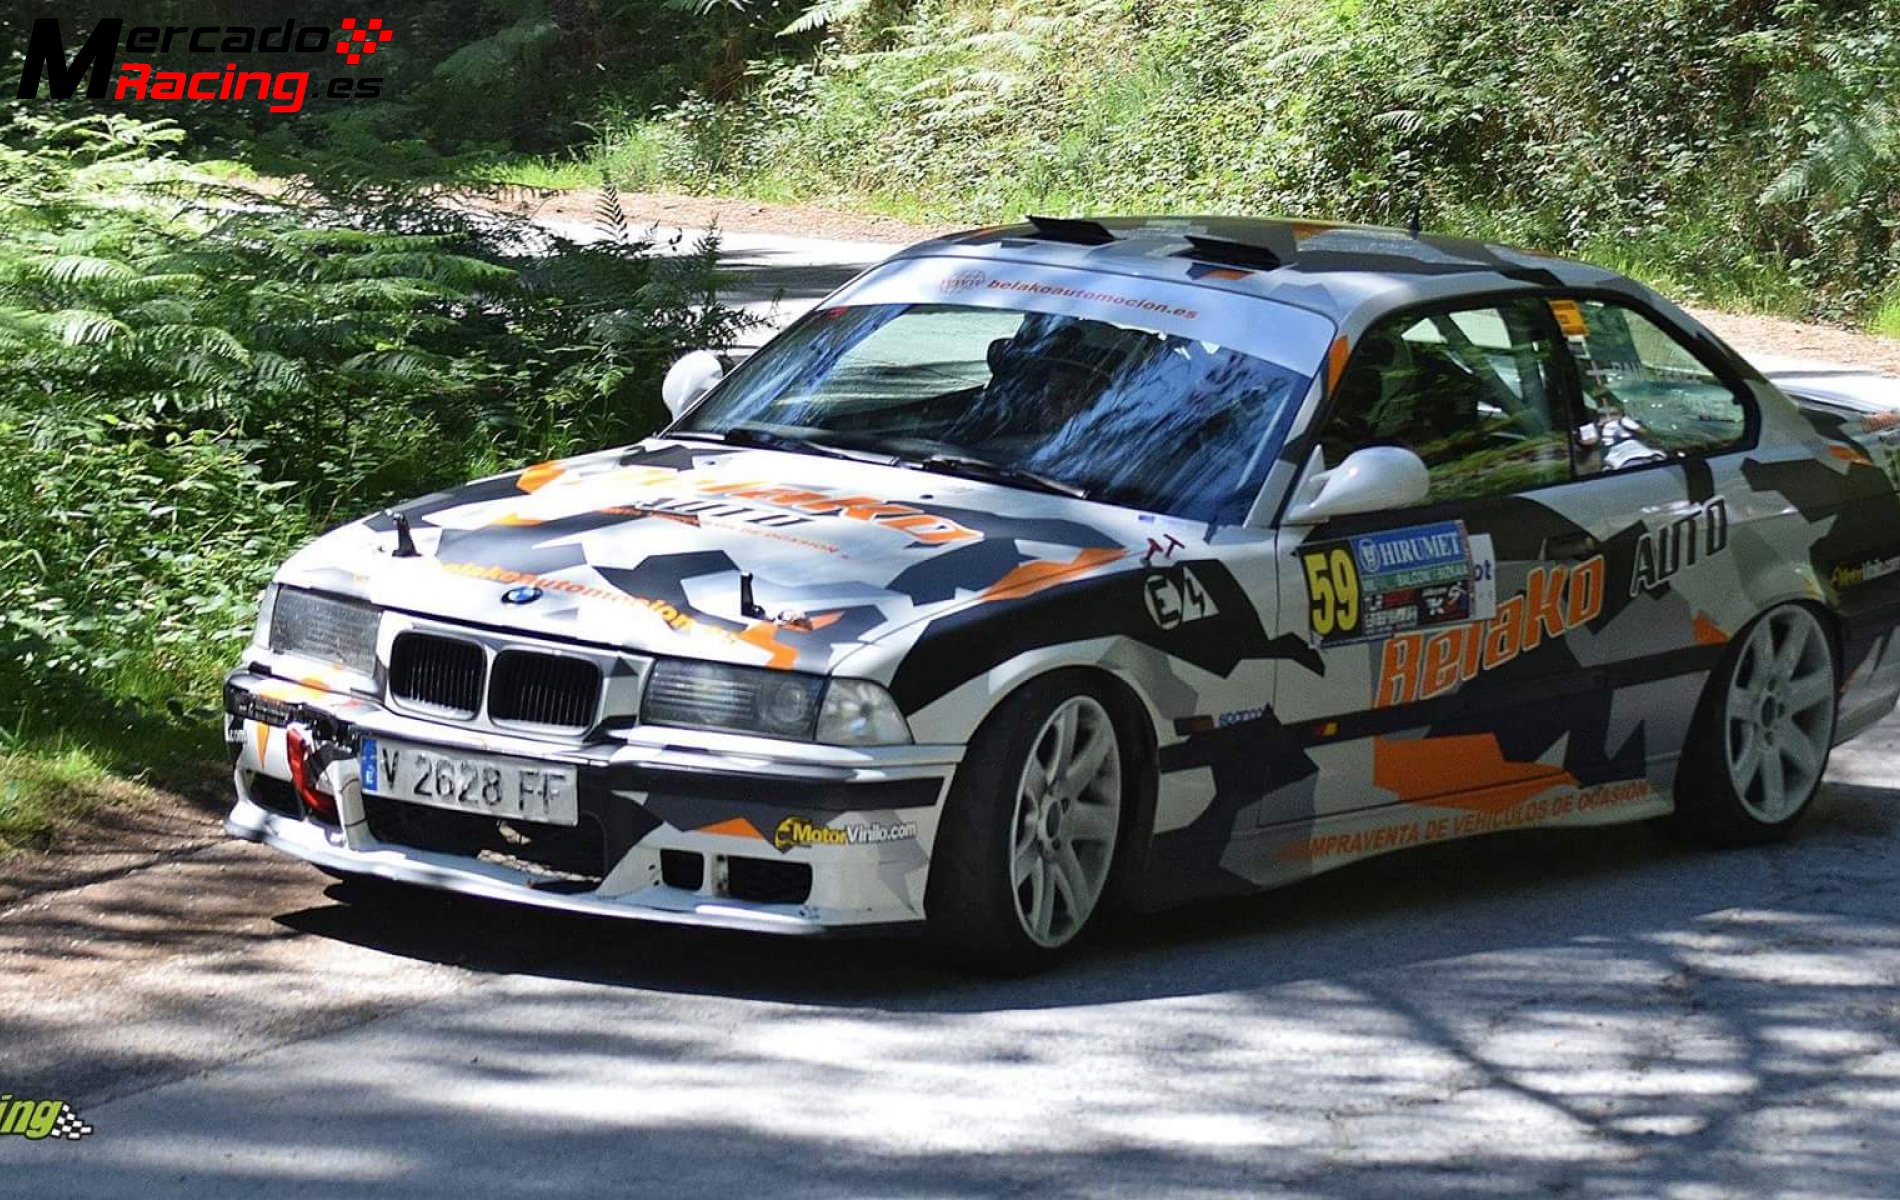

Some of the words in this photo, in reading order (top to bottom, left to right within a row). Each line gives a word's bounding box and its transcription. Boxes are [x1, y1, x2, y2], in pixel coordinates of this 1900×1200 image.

[1378, 531, 1460, 566] HIRUMET
[1629, 494, 1728, 598] AUTO
[1303, 549, 1359, 635] 59
[381, 747, 400, 791] V
[413, 754, 503, 806] 2628
[792, 822, 918, 846] MotorVinilo.com
[1274, 823, 1419, 864] MPRAVENTA
[1425, 818, 1450, 841] DE
